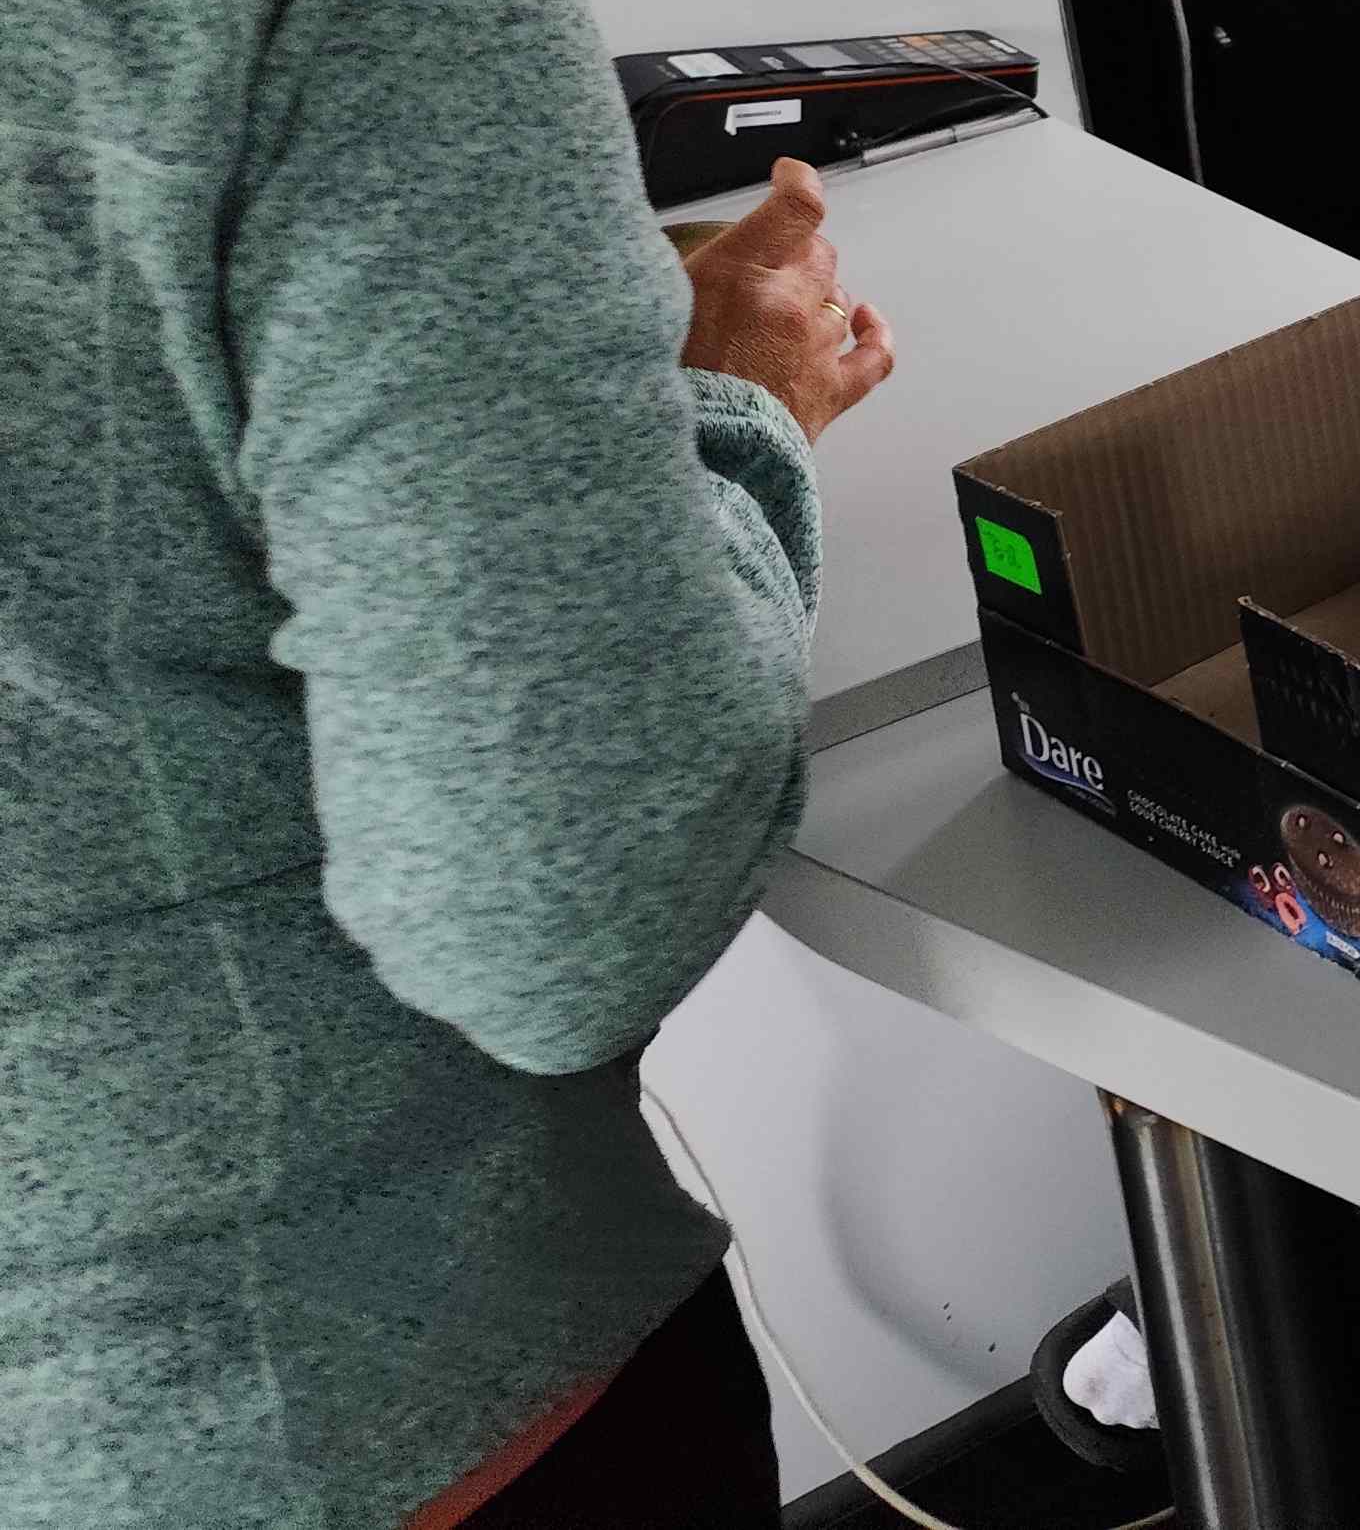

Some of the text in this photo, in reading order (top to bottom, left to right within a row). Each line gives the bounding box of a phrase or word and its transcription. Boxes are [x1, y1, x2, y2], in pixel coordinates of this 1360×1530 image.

[1020, 711, 1105, 792] Dare
[1127, 788, 1188, 832] CHOCOLATE
[1128, 800, 1157, 824] SOUR
